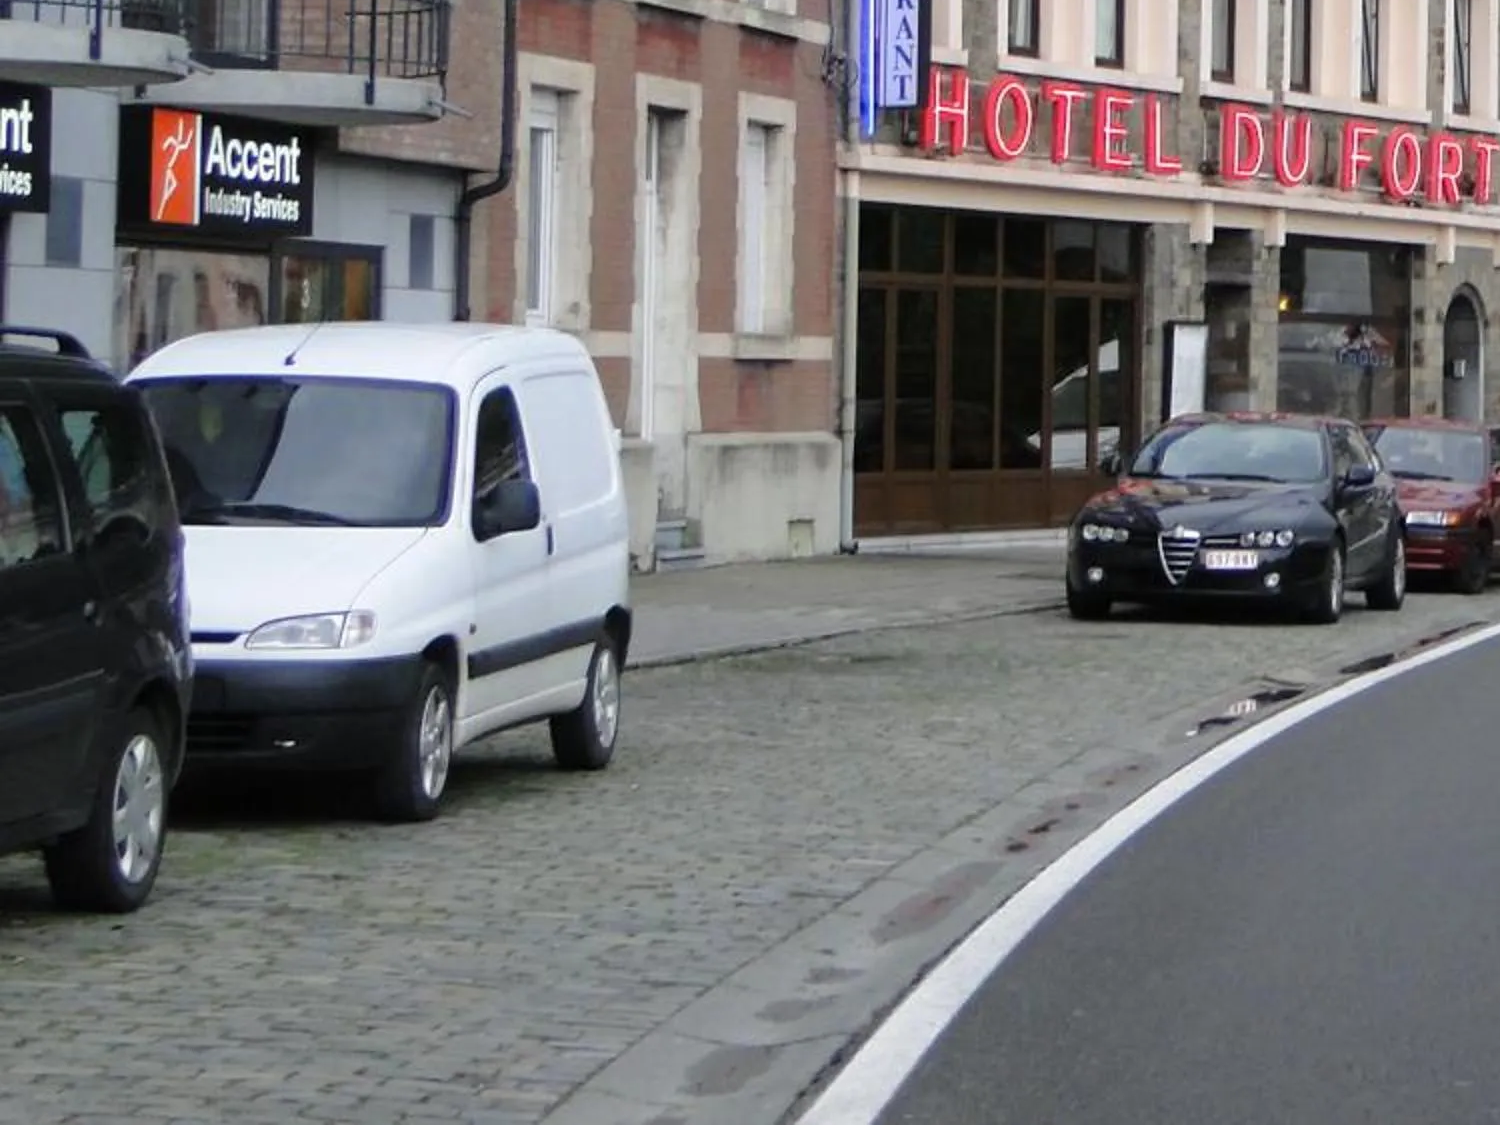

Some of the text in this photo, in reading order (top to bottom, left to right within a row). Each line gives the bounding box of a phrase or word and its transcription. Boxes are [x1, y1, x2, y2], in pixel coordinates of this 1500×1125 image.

[205, 124, 301, 185] Accent
[920, 64, 1500, 205] HOTEL DU FORT
[204, 186, 300, 223] Industry Services
